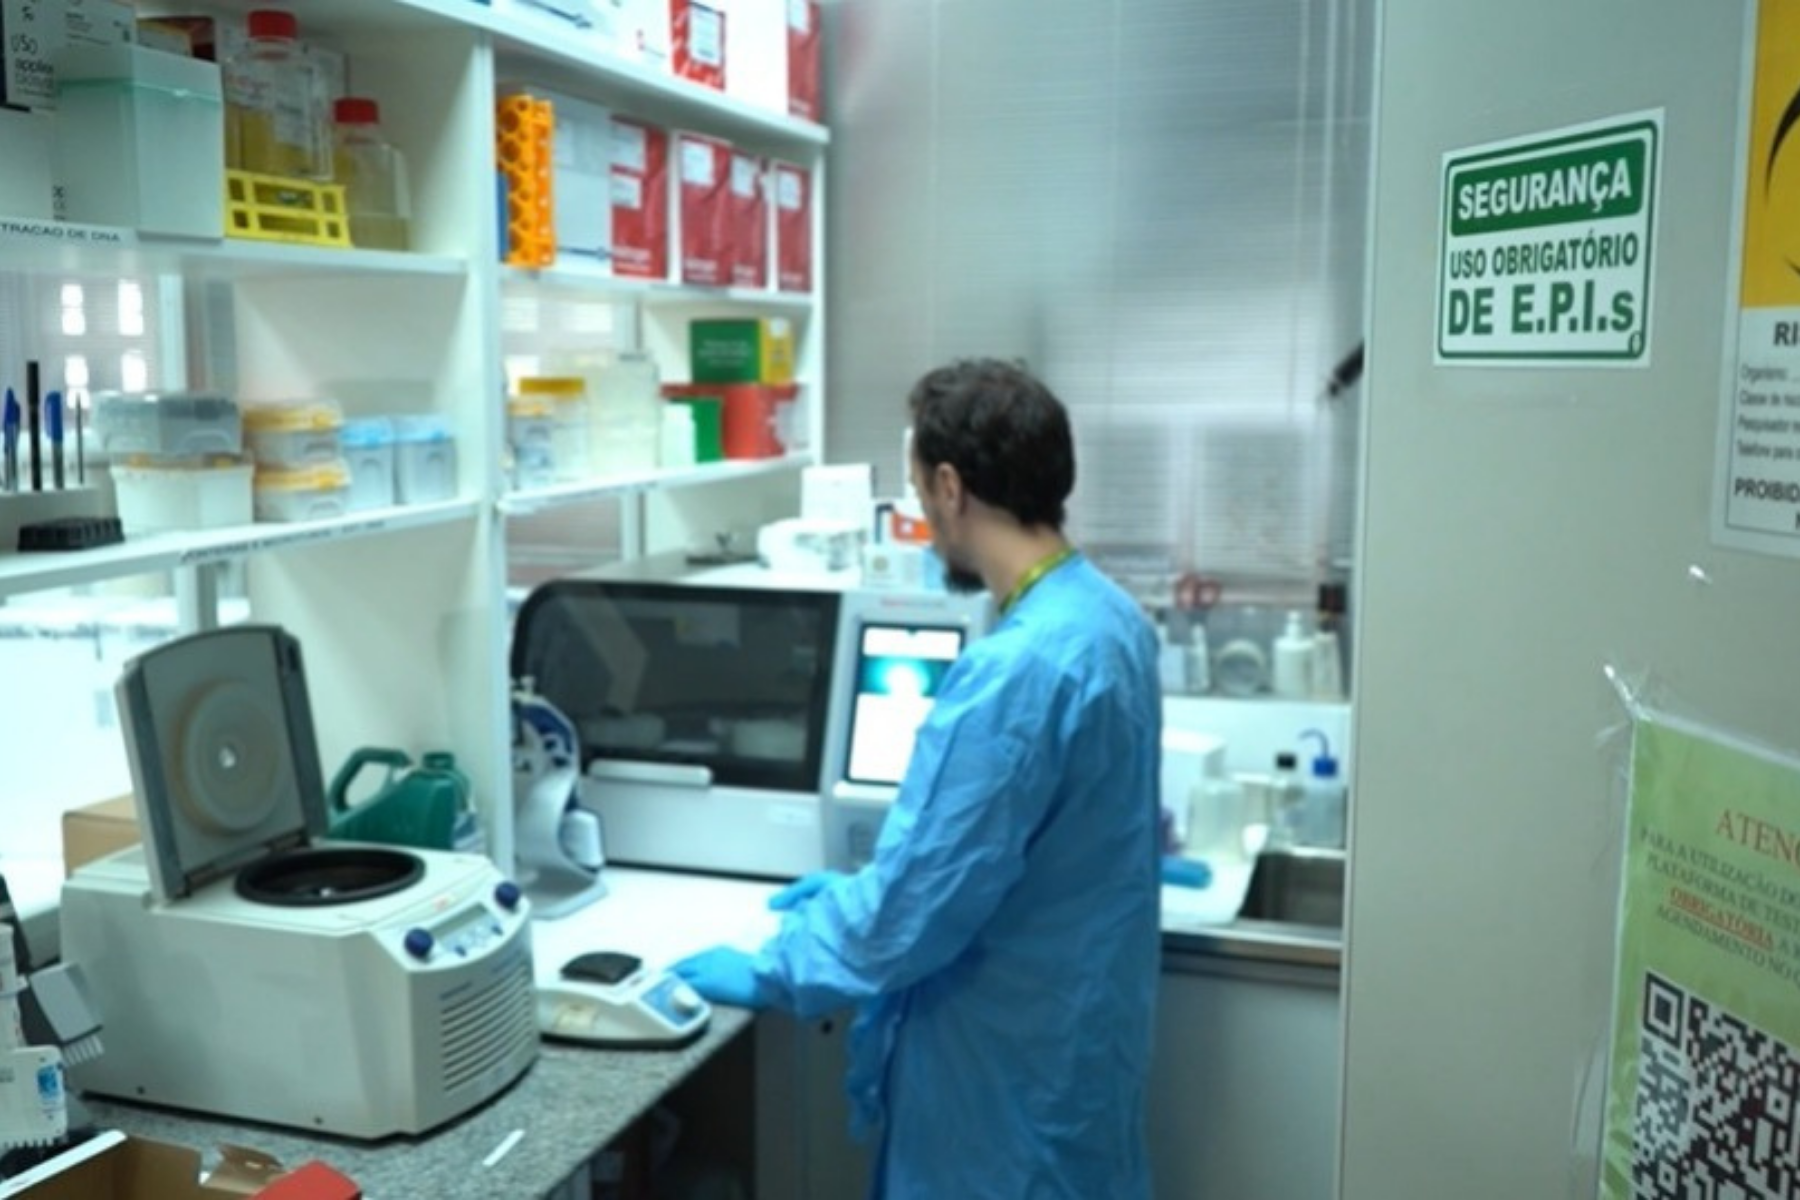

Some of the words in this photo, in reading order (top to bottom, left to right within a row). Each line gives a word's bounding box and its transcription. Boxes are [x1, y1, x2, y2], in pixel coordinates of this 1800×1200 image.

[1458, 157, 1632, 220] SEGURANÇA
[1450, 248, 1487, 279] USO
[1492, 227, 1640, 276] OBRIGATÓRIO
[1448, 287, 1494, 336] DE
[1511, 279, 1634, 335] E.P.I.s
[1774, 321, 1800, 347] RI
